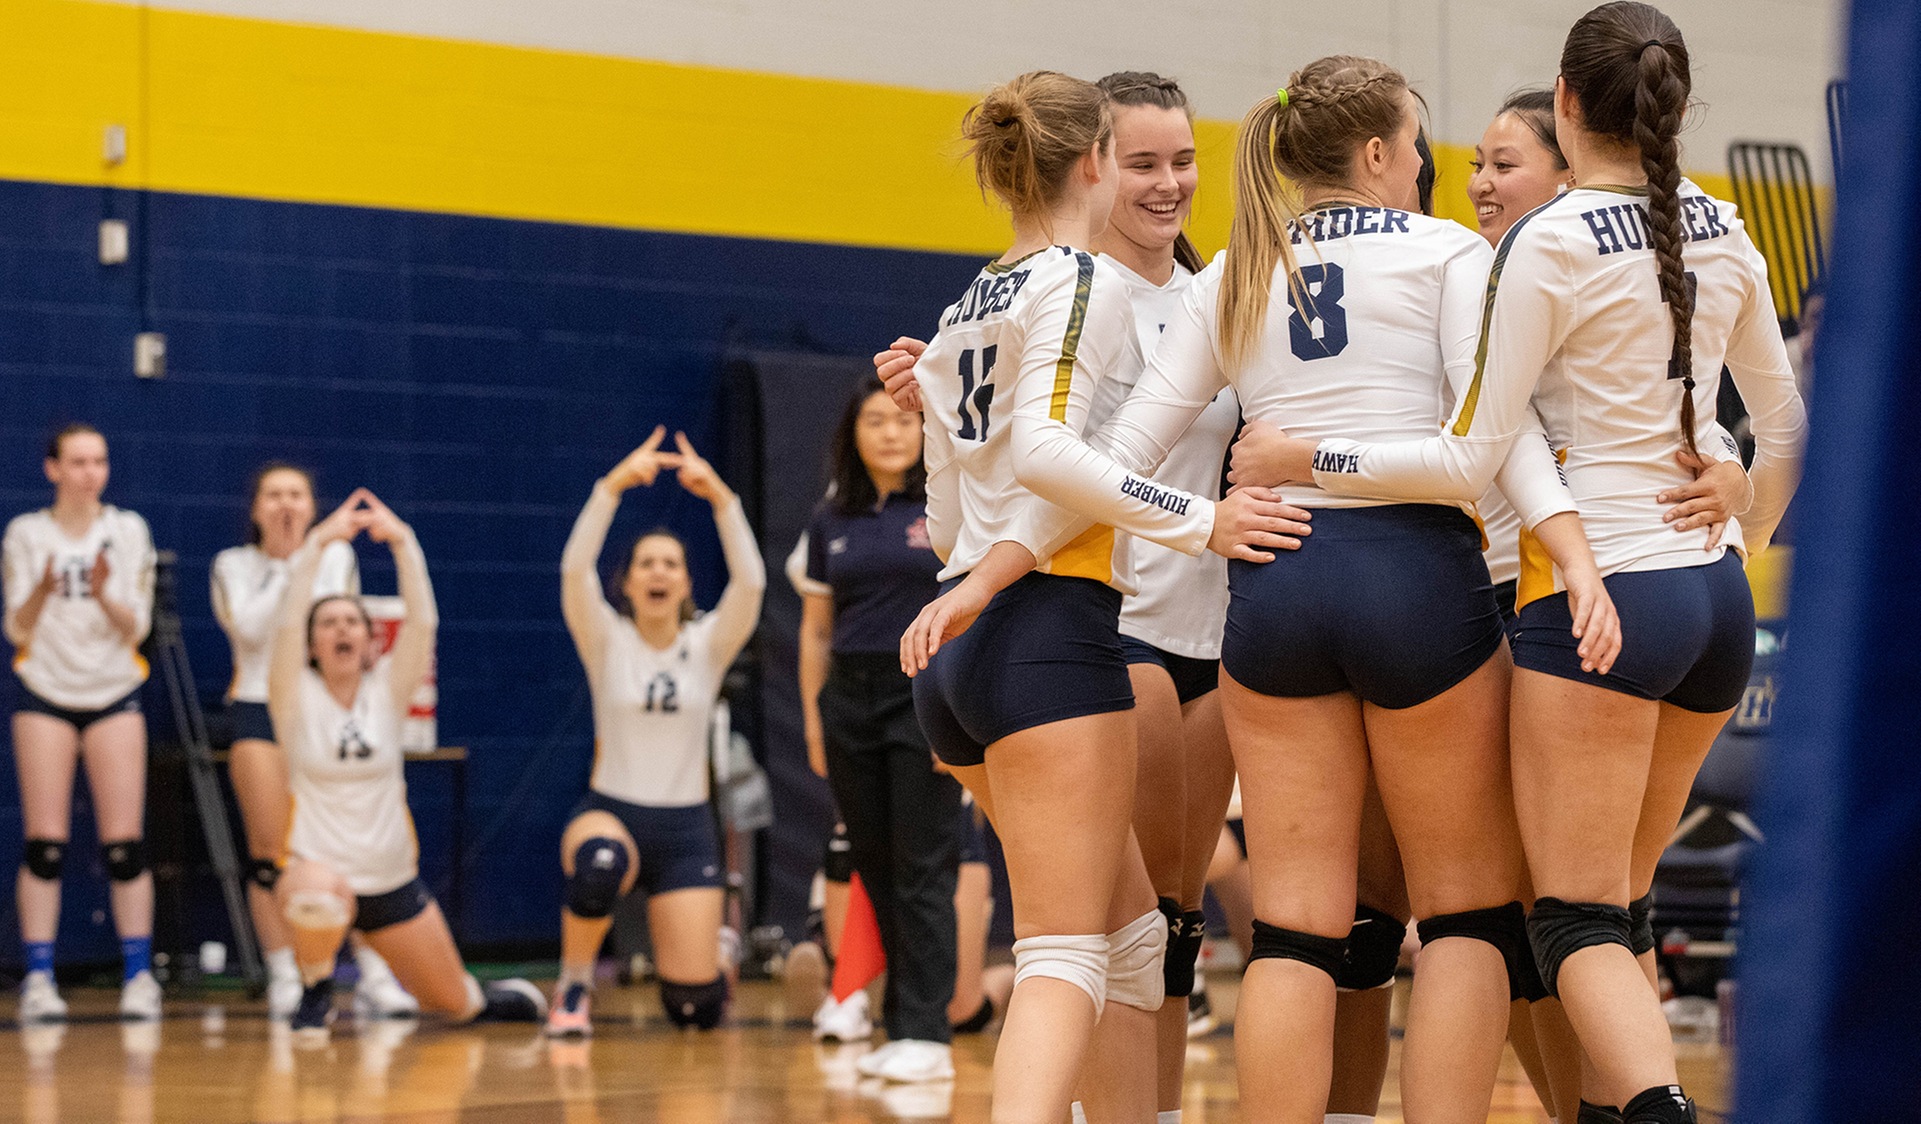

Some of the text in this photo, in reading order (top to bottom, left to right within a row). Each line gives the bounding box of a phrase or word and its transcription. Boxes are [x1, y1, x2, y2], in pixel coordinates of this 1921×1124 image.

[1287, 206, 1410, 245] MBER
[1287, 262, 1349, 362] 8
[1120, 475, 1191, 516] HUMBER
[645, 679, 679, 713] 12
